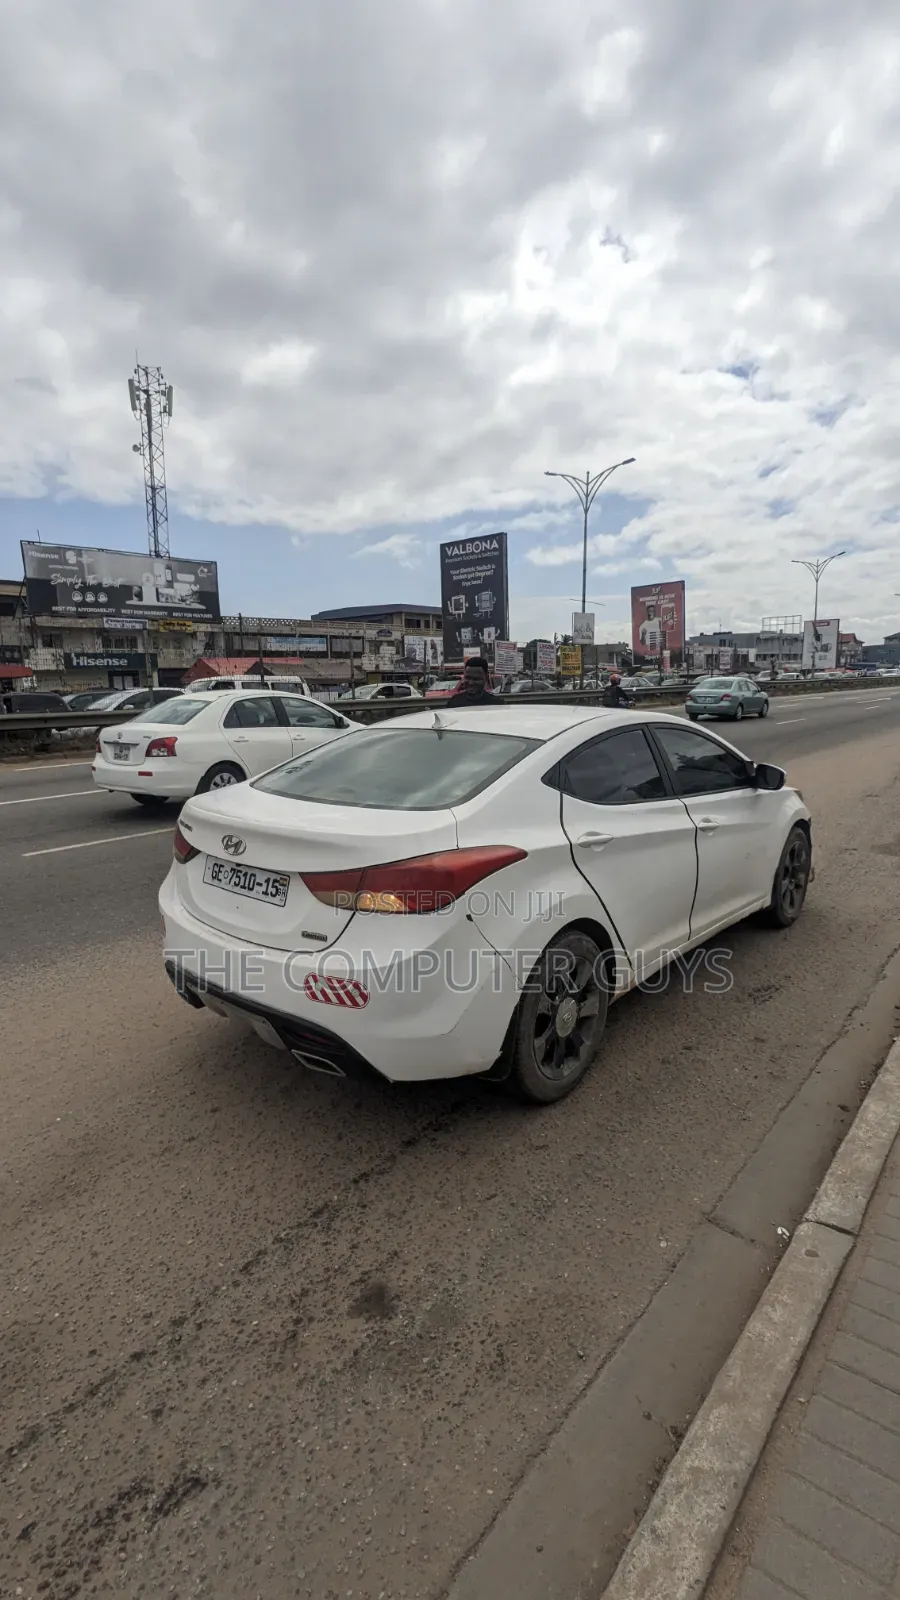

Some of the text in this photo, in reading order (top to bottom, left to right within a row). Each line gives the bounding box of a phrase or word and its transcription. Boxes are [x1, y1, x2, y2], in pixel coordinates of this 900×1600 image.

[29, 550, 59, 560] Hisense
[445, 539, 498, 556] VALBONA
[50, 573, 122, 589] Simply The Best
[72, 656, 128, 666] Hisense
[211, 862, 280, 898] GE 7510-15
